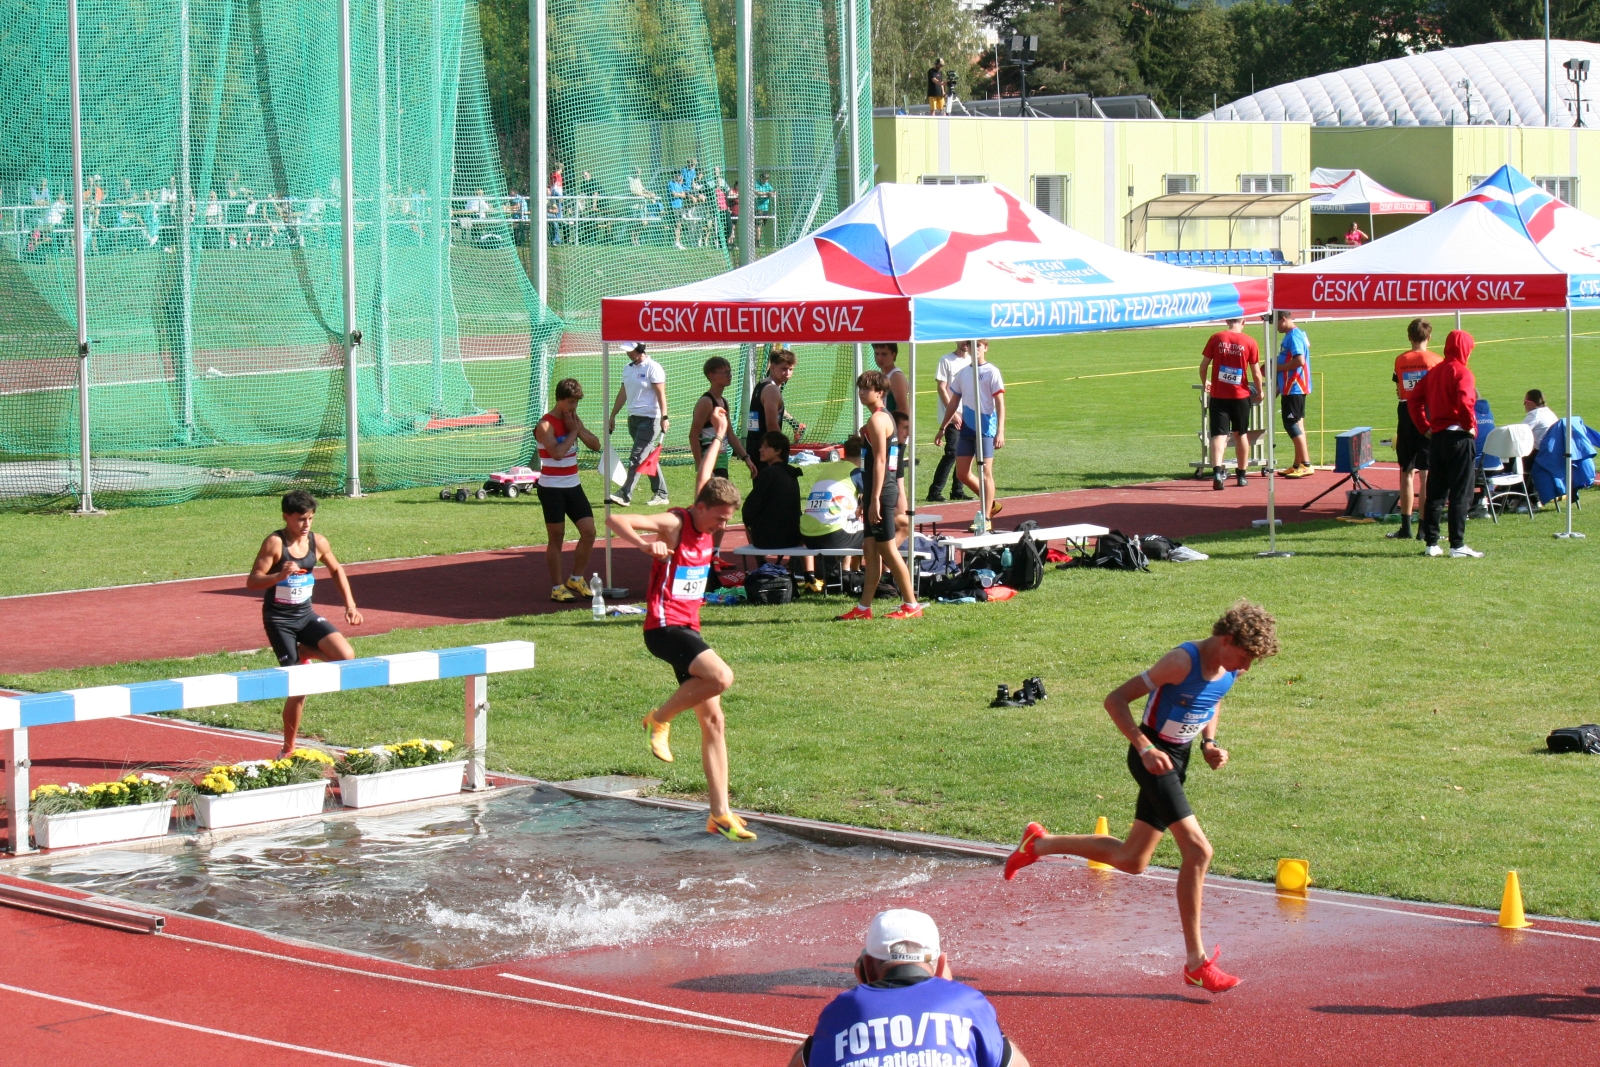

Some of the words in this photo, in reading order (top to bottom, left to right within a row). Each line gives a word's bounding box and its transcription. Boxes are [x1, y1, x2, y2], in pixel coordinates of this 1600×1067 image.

[1311, 275, 1371, 302] ČESKÝ
[1373, 276, 1471, 302] ATLETICKÝ
[1476, 280, 1526, 301] SVAZ
[638, 302, 699, 333] ČESKÝ
[703, 302, 806, 333] ATLETICKÝ
[812, 305, 864, 332] SVAZ
[991, 301, 1045, 328] CZECH
[1048, 298, 1121, 326] ATHLETIC
[1124, 291, 1212, 321] FEDERATION
[1222, 373, 1237, 382] 464
[810, 500, 823, 508] 121
[683, 581, 702, 594] 497
[835, 1012, 973, 1062] FOTO/TV
[838, 1049, 971, 1067] w.atletika.cz
